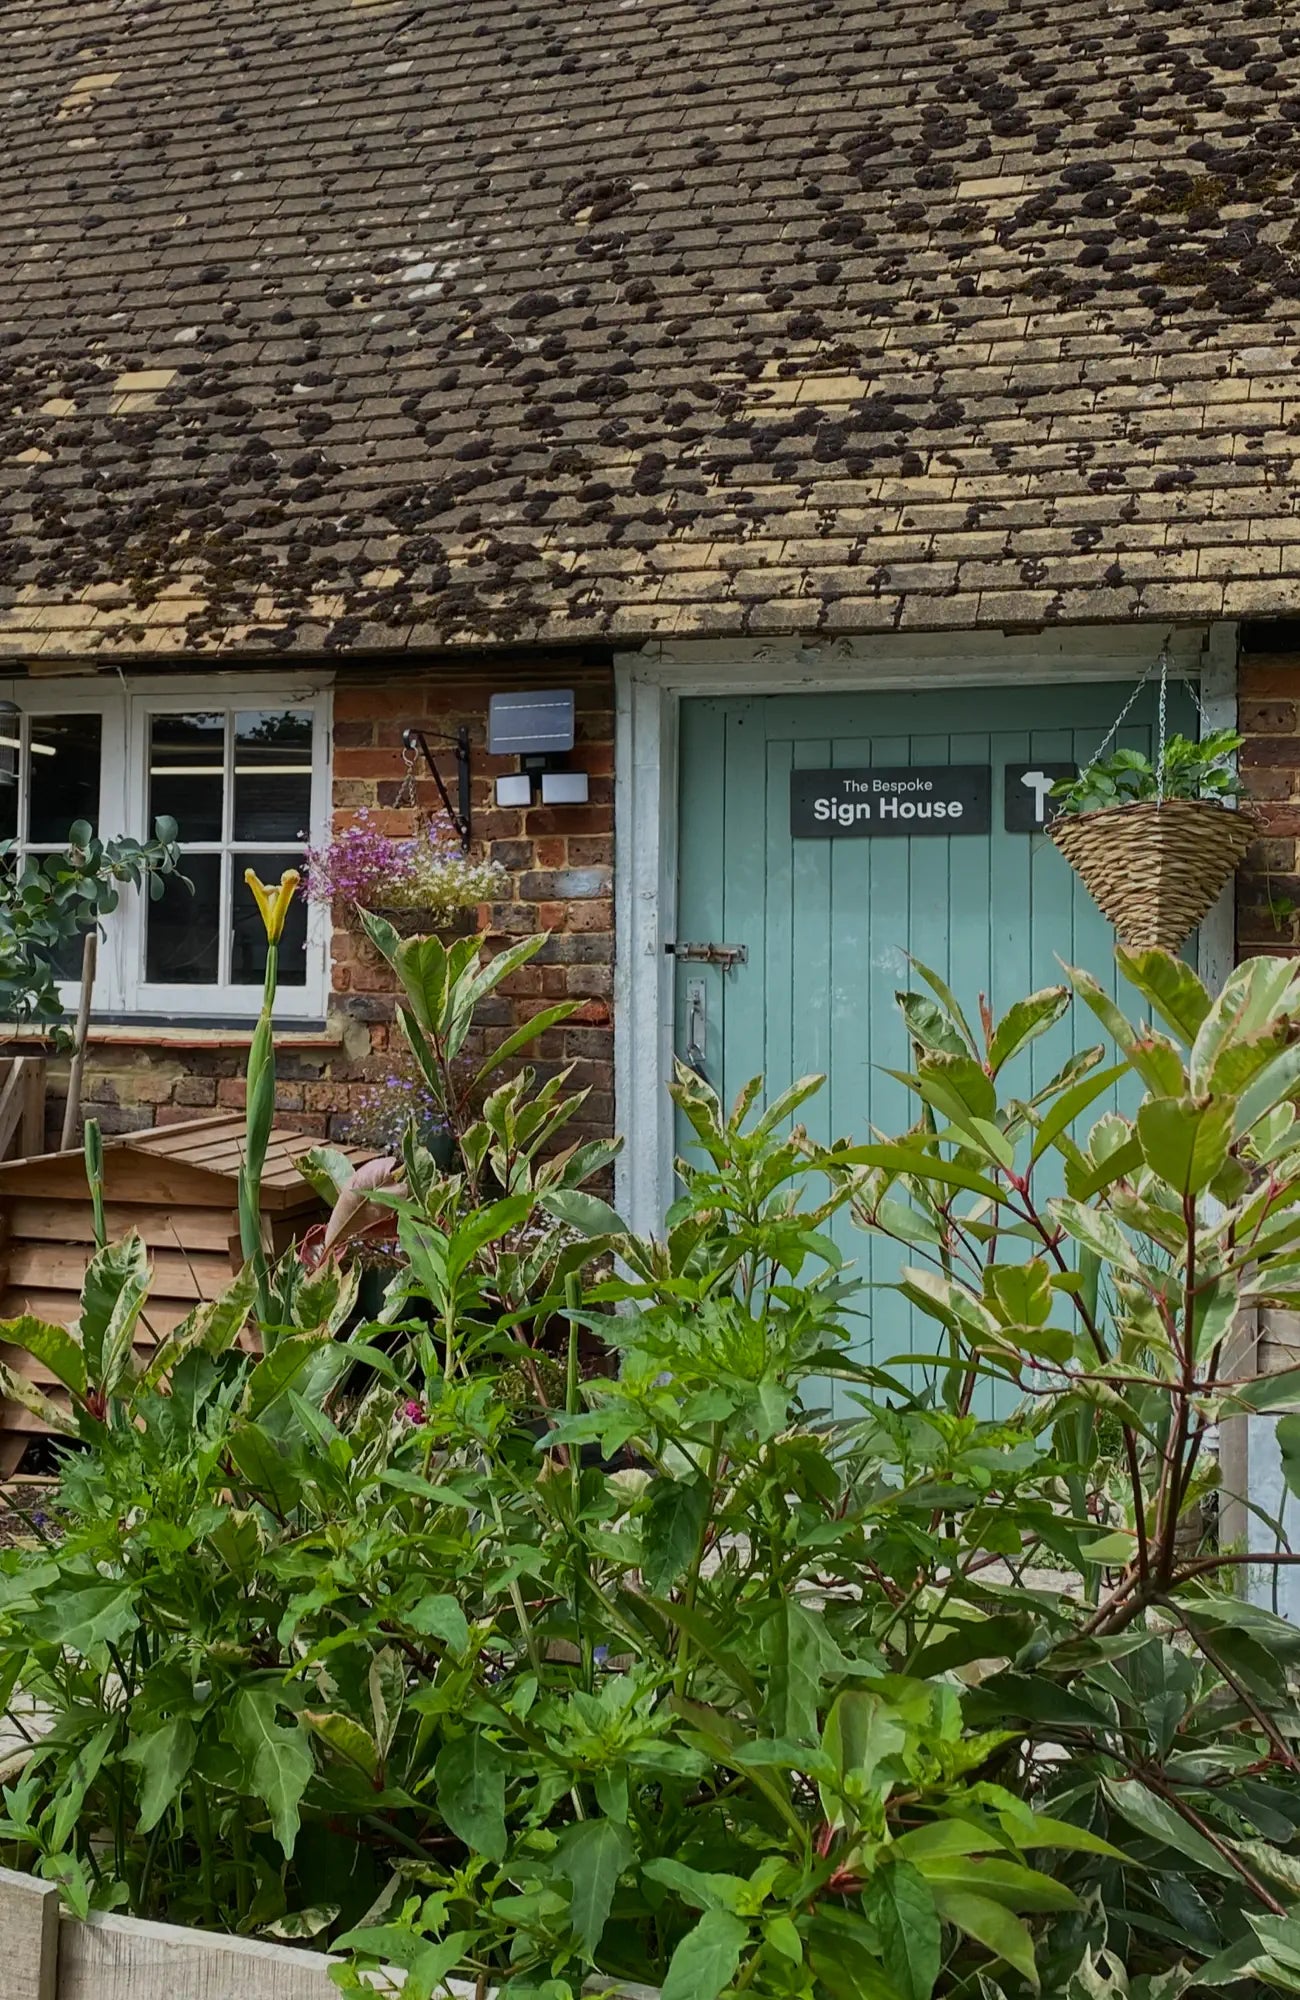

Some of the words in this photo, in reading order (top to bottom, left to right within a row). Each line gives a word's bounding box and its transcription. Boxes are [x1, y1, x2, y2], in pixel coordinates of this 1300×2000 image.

[844, 780, 868, 792] The
[873, 778, 932, 794] Bespoke
[814, 798, 870, 826] Sign
[880, 797, 963, 818] House
